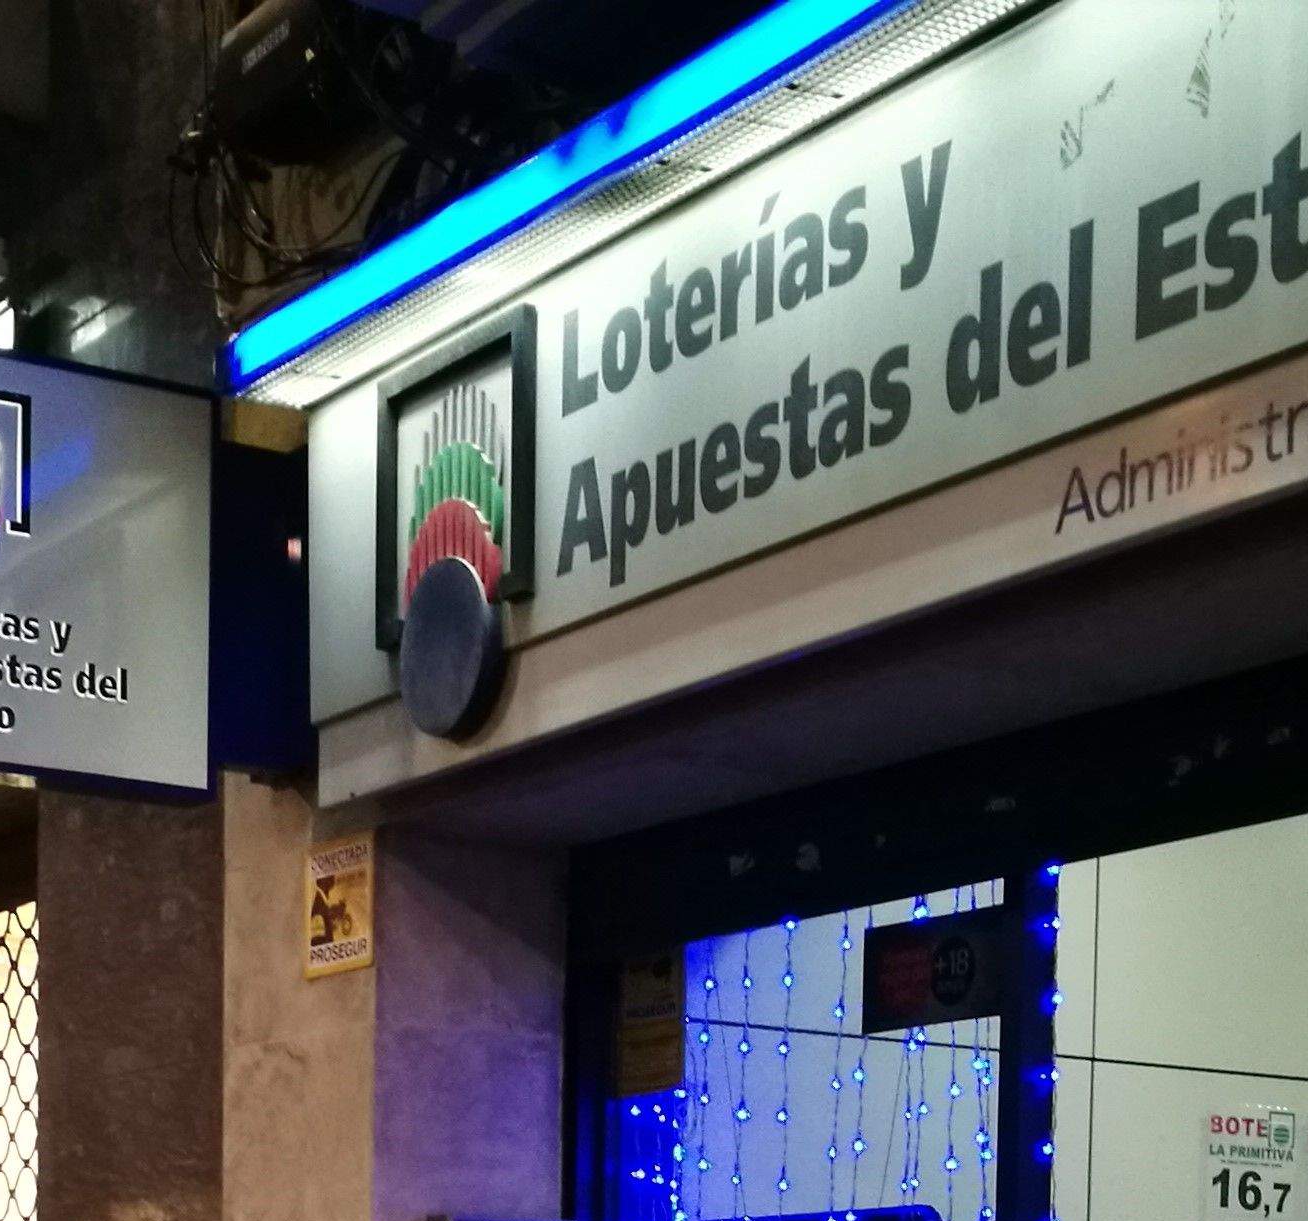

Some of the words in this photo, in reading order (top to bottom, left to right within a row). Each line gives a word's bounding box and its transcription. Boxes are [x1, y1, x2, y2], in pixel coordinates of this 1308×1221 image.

[562, 191, 869, 417] Loterías
[900, 140, 953, 291] y
[556, 342, 912, 588] Apuestas
[945, 219, 1094, 414] del
[51, 617, 73, 656] y
[74, 667, 129, 703] del
[1210, 1115, 1268, 1138] BOTE
[1209, 1144, 1225, 1156] LA
[1230, 1145, 1294, 1162] PRIMITIVA
[1212, 1167, 1292, 1218] 16,7
